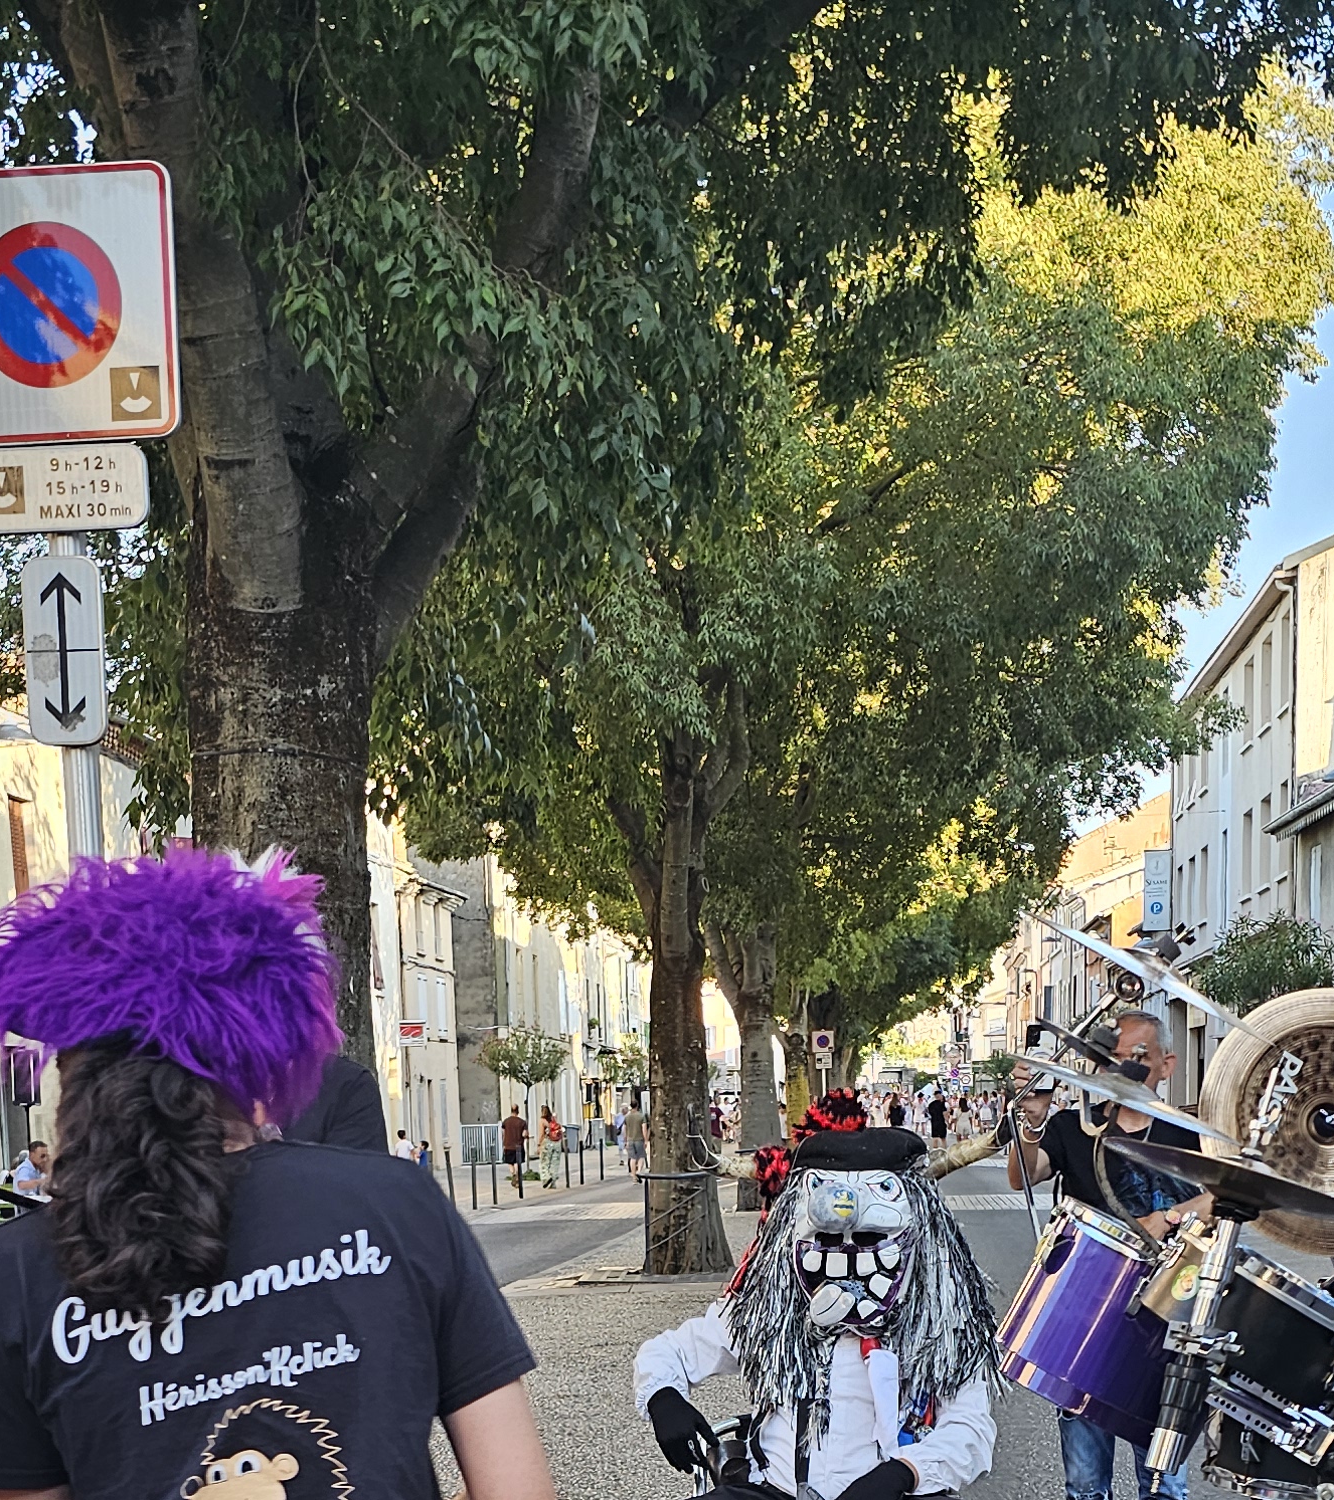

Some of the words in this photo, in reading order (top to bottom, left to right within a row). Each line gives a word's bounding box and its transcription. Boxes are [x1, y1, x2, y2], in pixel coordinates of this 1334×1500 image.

[39, 503, 81, 519] MAXI
[86, 502, 107, 517] 30
[110, 505, 132, 516] min
